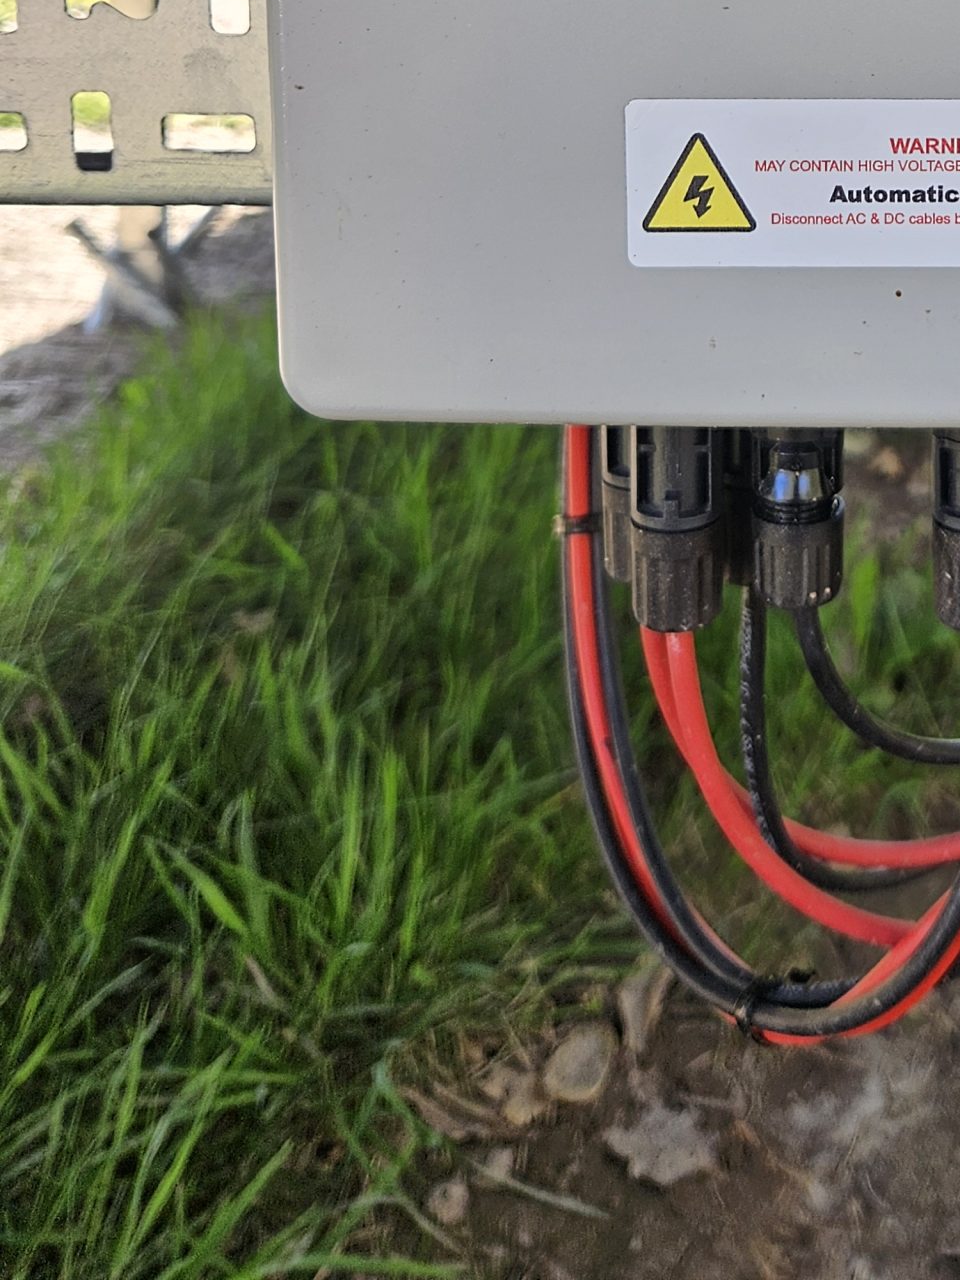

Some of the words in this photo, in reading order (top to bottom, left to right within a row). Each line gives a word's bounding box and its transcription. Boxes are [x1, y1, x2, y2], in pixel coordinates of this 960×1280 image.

[754, 159, 786, 172] MAY
[789, 159, 854, 173] CONTAIN
[858, 159, 894, 173] HIGH
[829, 184, 960, 204] Automatic
[771, 212, 843, 225] Disconnect
[845, 212, 867, 225] AC
[870, 212, 881, 225] &
[884, 212, 905, 225] DC
[908, 212, 951, 225] cables
